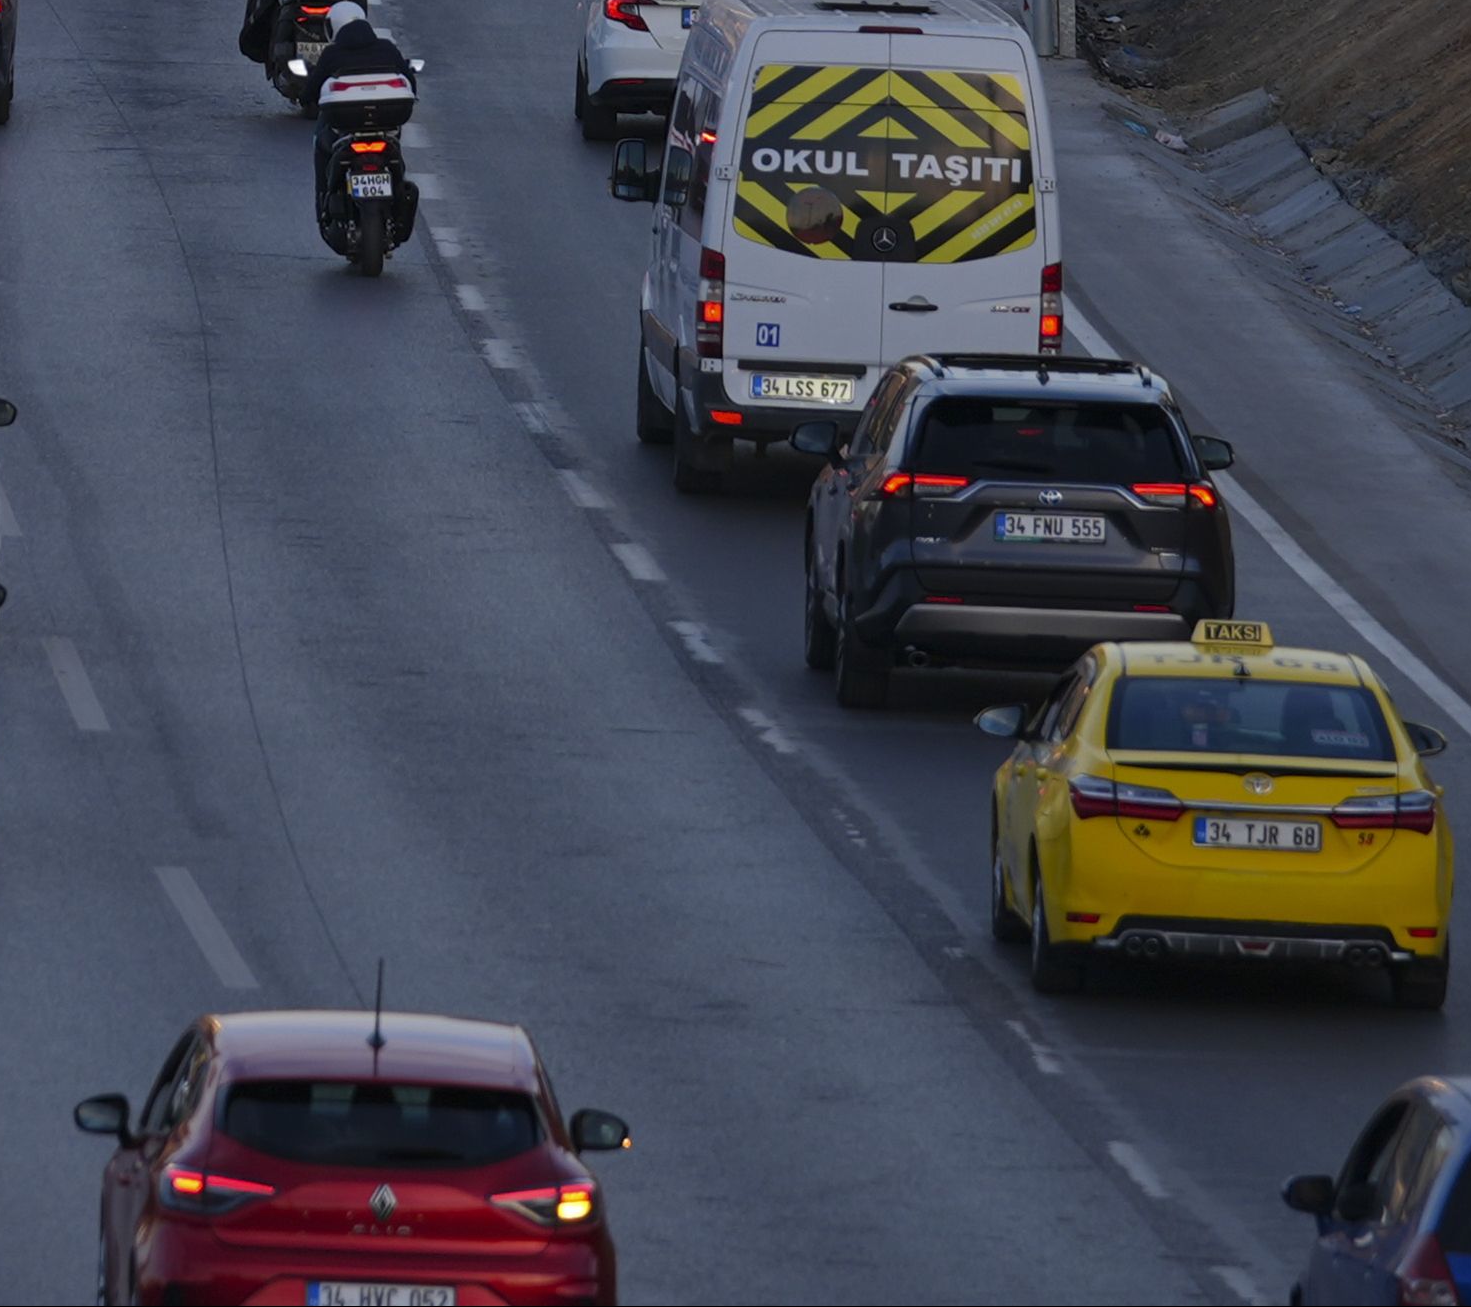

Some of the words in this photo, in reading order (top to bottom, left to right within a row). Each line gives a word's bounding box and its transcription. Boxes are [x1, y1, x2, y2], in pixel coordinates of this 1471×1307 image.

[750, 147, 870, 178] OKUL
[891, 151, 1023, 187] TAŞITI
[362, 186, 385, 197] 604
[758, 325, 779, 345] 01
[762, 377, 780, 394] 34
[786, 379, 814, 396] LSS
[820, 380, 848, 399] 677
[1005, 515, 1026, 534] 34
[1032, 516, 1064, 535] FNU
[1071, 517, 1102, 537] 555
[1205, 623, 1260, 642] TAKSİ
[1210, 822, 1231, 842] 34
[1247, 824, 1279, 844] TJR
[1292, 826, 1316, 846] 68
